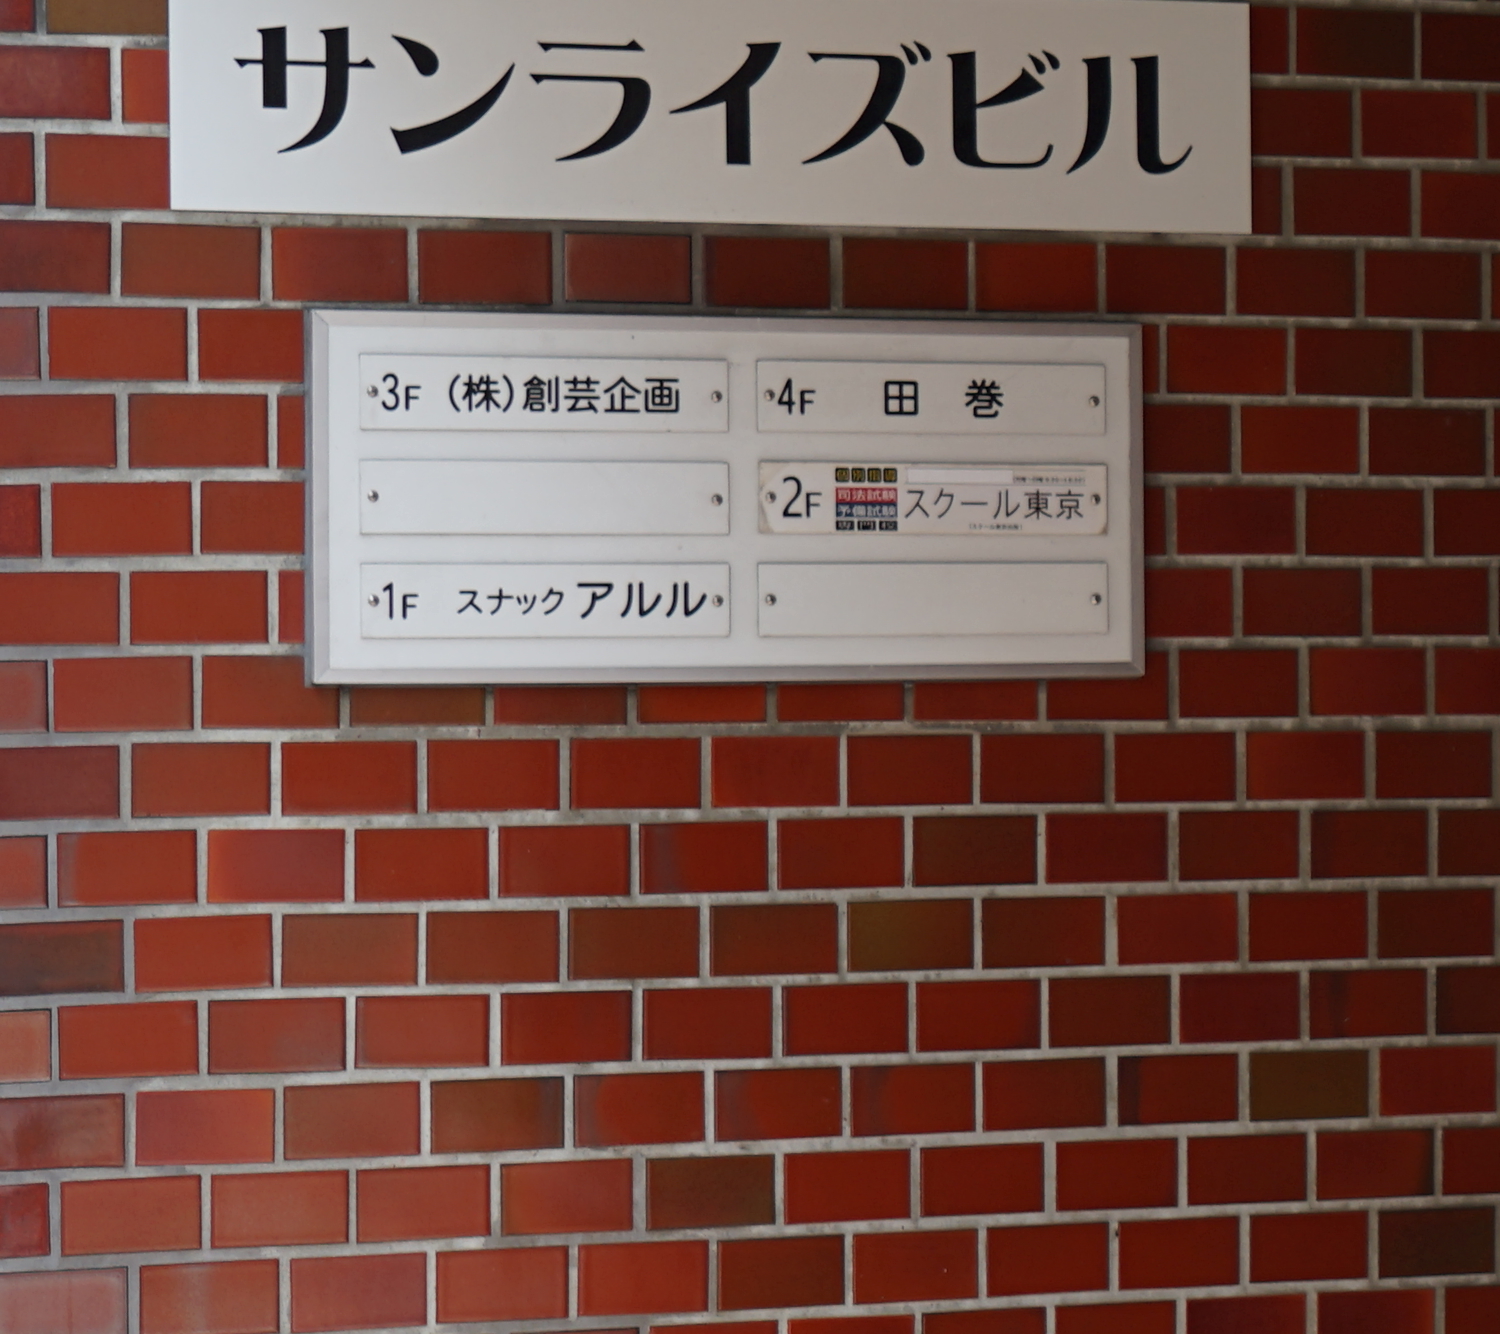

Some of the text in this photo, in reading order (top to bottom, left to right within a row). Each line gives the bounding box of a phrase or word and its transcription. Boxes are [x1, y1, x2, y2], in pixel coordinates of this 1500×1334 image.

[234, 25, 1194, 176] サンライズビル
[381, 372, 422, 411] 3F
[777, 377, 817, 415] 4F
[782, 475, 1085, 520] 2F スクール東京
[382, 581, 707, 619] 1F スナック アルル
